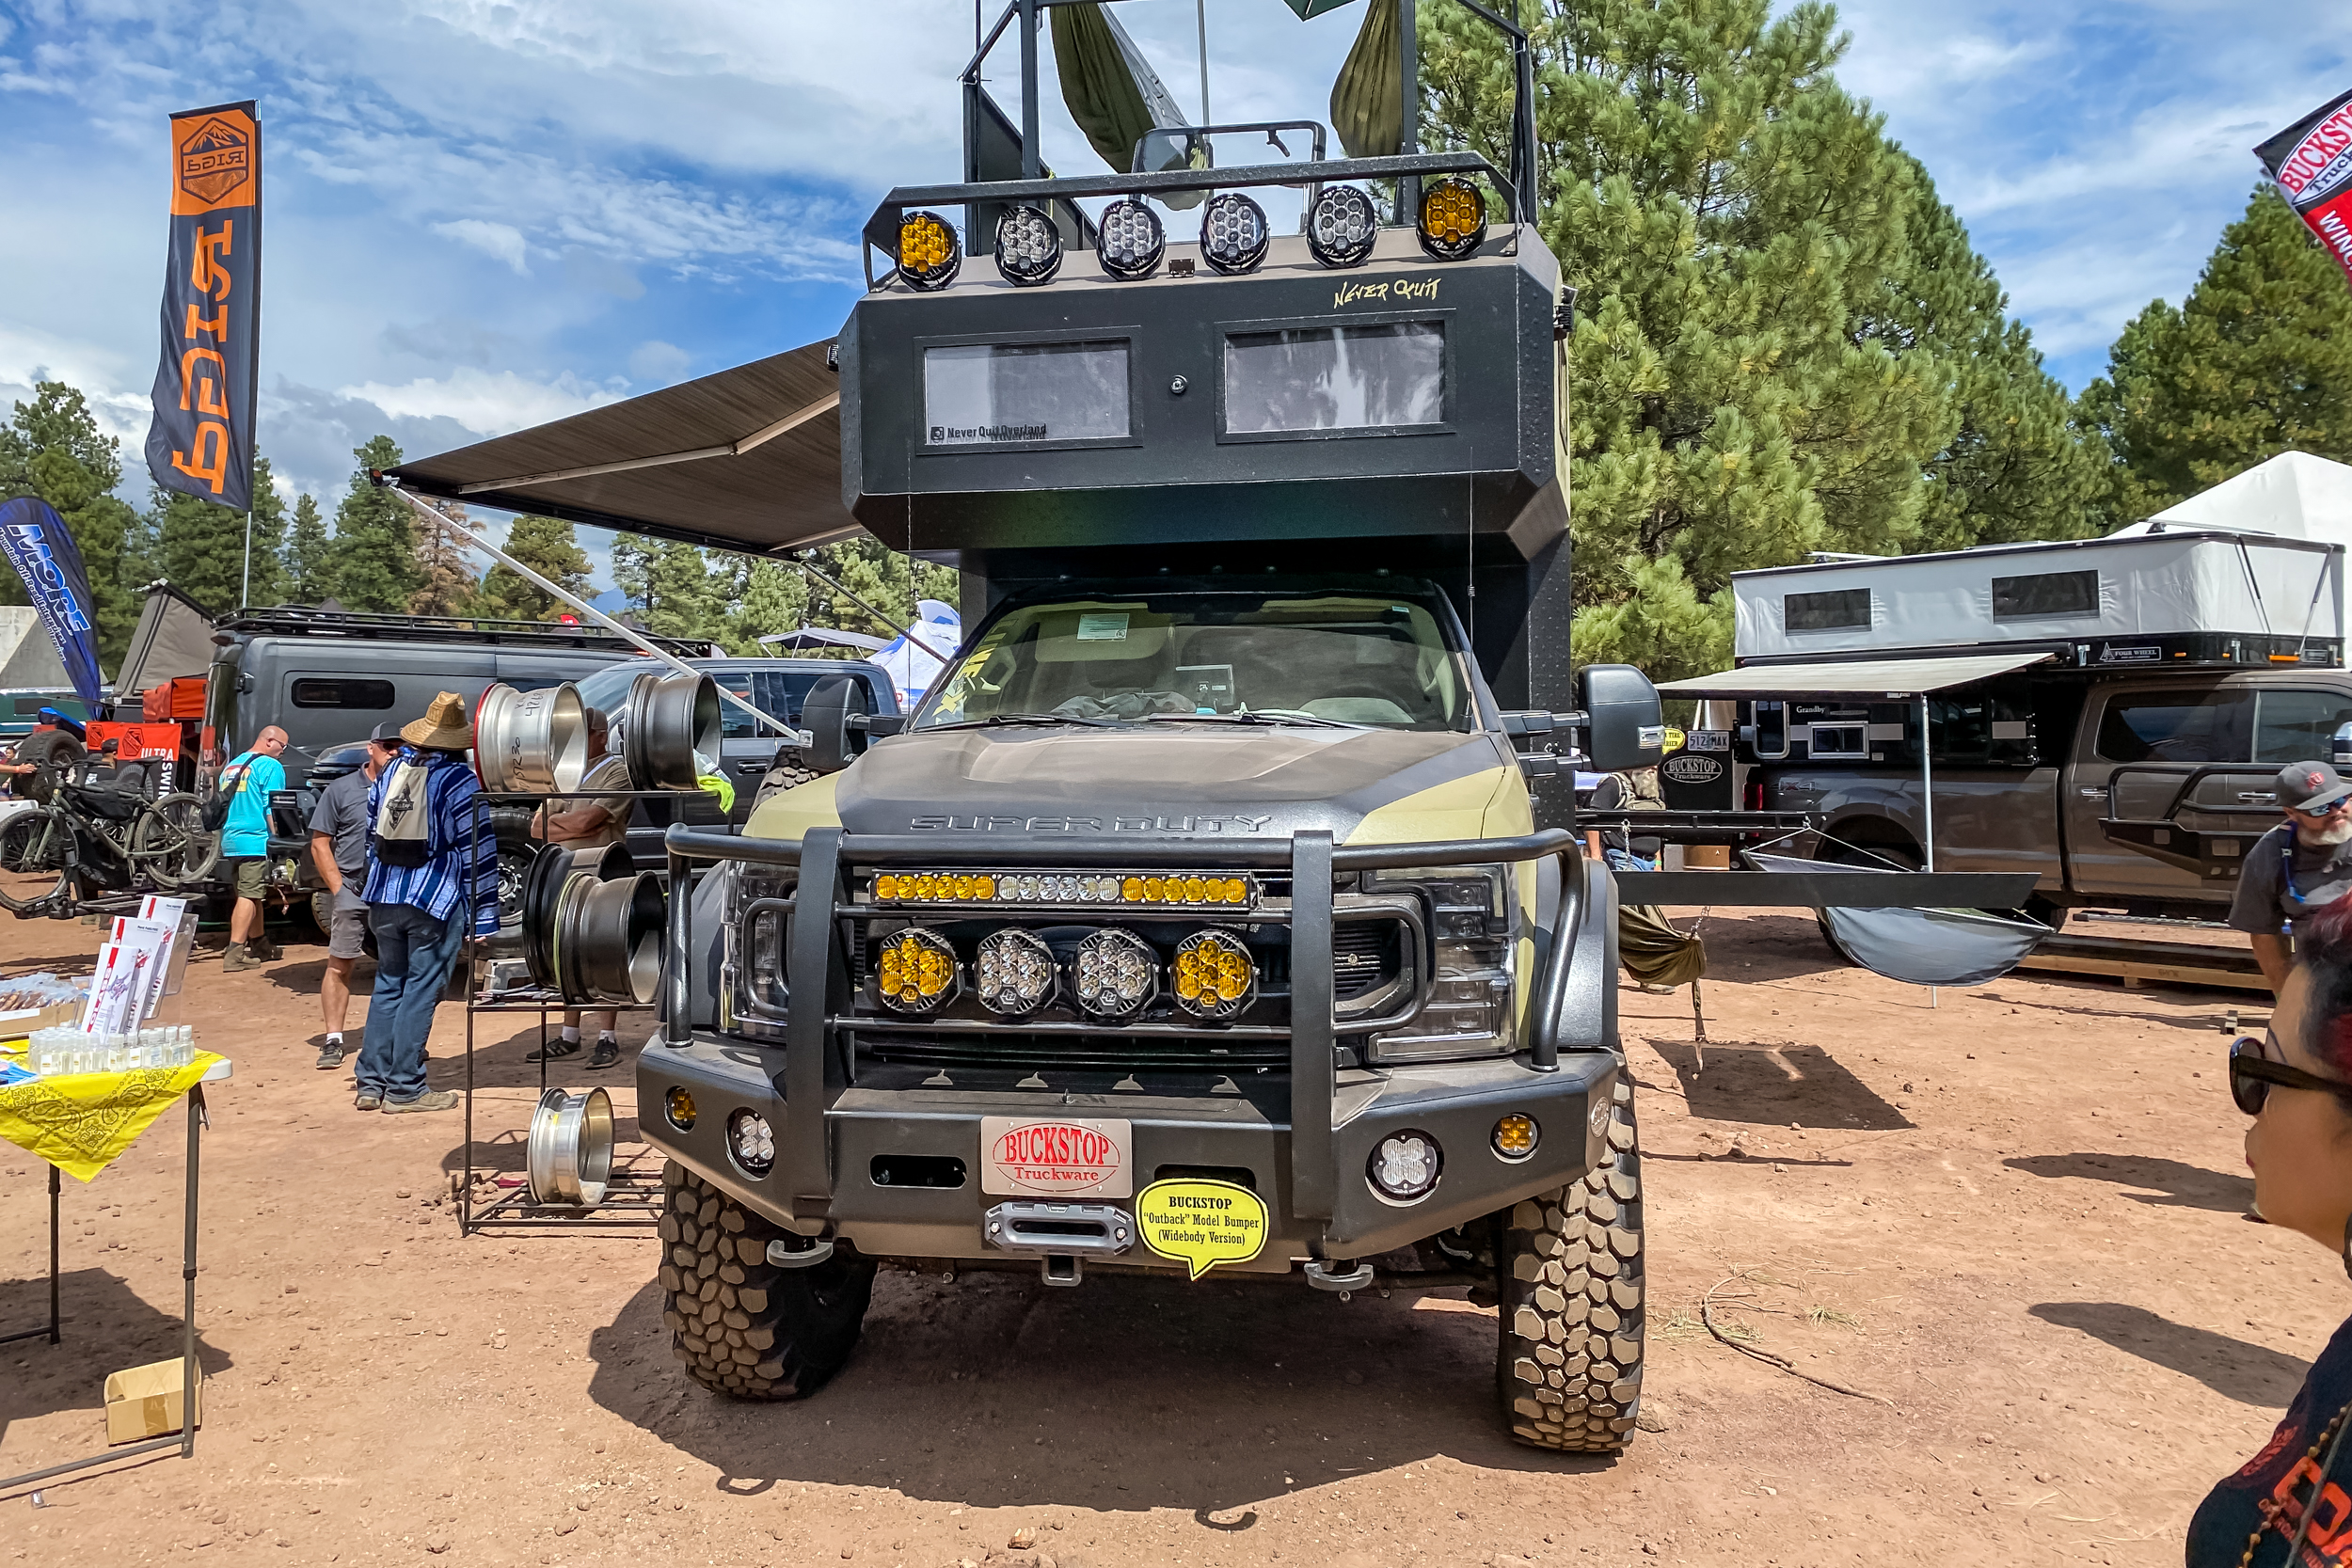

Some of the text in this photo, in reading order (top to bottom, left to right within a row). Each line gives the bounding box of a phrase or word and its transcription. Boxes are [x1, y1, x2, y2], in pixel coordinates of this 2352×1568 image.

[1333, 280, 1390, 309] NEVER
[947, 422, 1047, 439] Never Quit Overland
[1796, 705, 1826, 714] Grandby
[1690, 736, 1727, 746] 512 MAX
[1669, 758, 1717, 772] BUCKSTOP
[158, 763, 173, 800] SWIN
[909, 813, 1272, 833] SUPER DUTY
[1004, 1127, 1110, 1165] BUCKSTOP
[1014, 1166, 1099, 1181] Truckware
[1168, 1196, 1232, 1211] BUCKSTOP
[1192, 1213, 1220, 1227] Model
[1224, 1215, 1260, 1229] Bumper
[1158, 1229, 1247, 1246] (Widebody Version)
